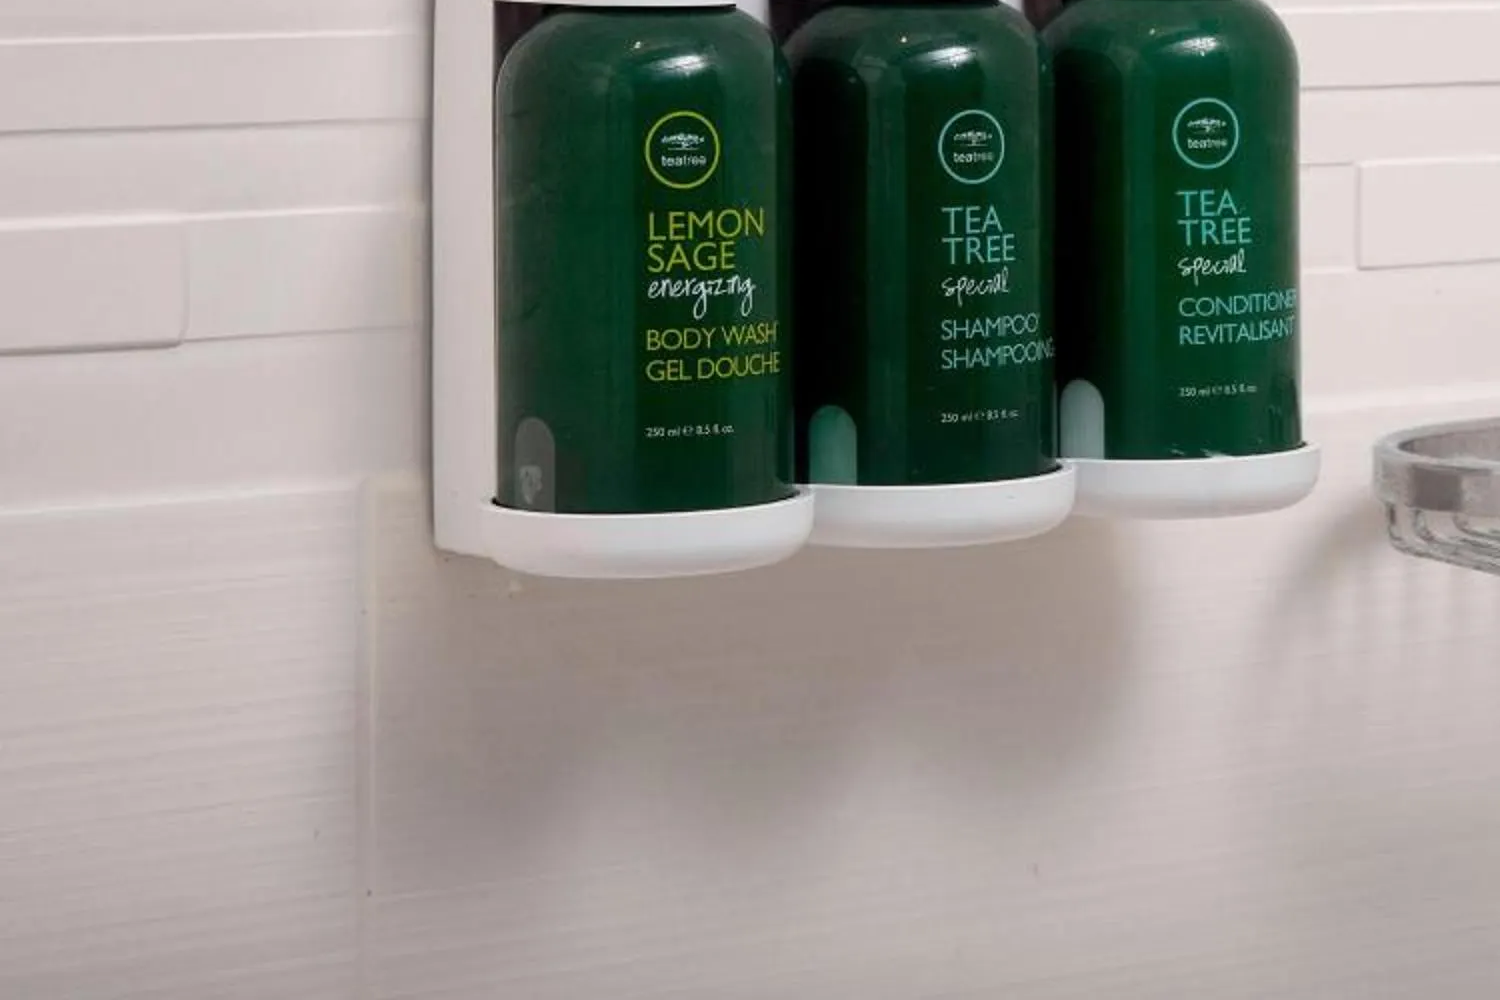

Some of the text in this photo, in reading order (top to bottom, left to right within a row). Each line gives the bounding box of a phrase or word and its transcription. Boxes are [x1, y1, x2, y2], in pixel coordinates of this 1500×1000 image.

[1176, 189, 1238, 217] TEA
[649, 208, 765, 241] LEMON
[941, 204, 1004, 235] TEA
[1177, 216, 1252, 247] TREE
[647, 241, 737, 273] SAGE
[941, 233, 1017, 265] TREE
[1177, 248, 1247, 287] special
[647, 274, 757, 320] energizing
[941, 265, 1010, 308] special
[646, 320, 778, 351] BODY WASH
[941, 312, 1040, 341] SHAMPOO
[1179, 315, 1296, 346] REVITALISANT
[645, 351, 781, 382] GEL DOUCHE
